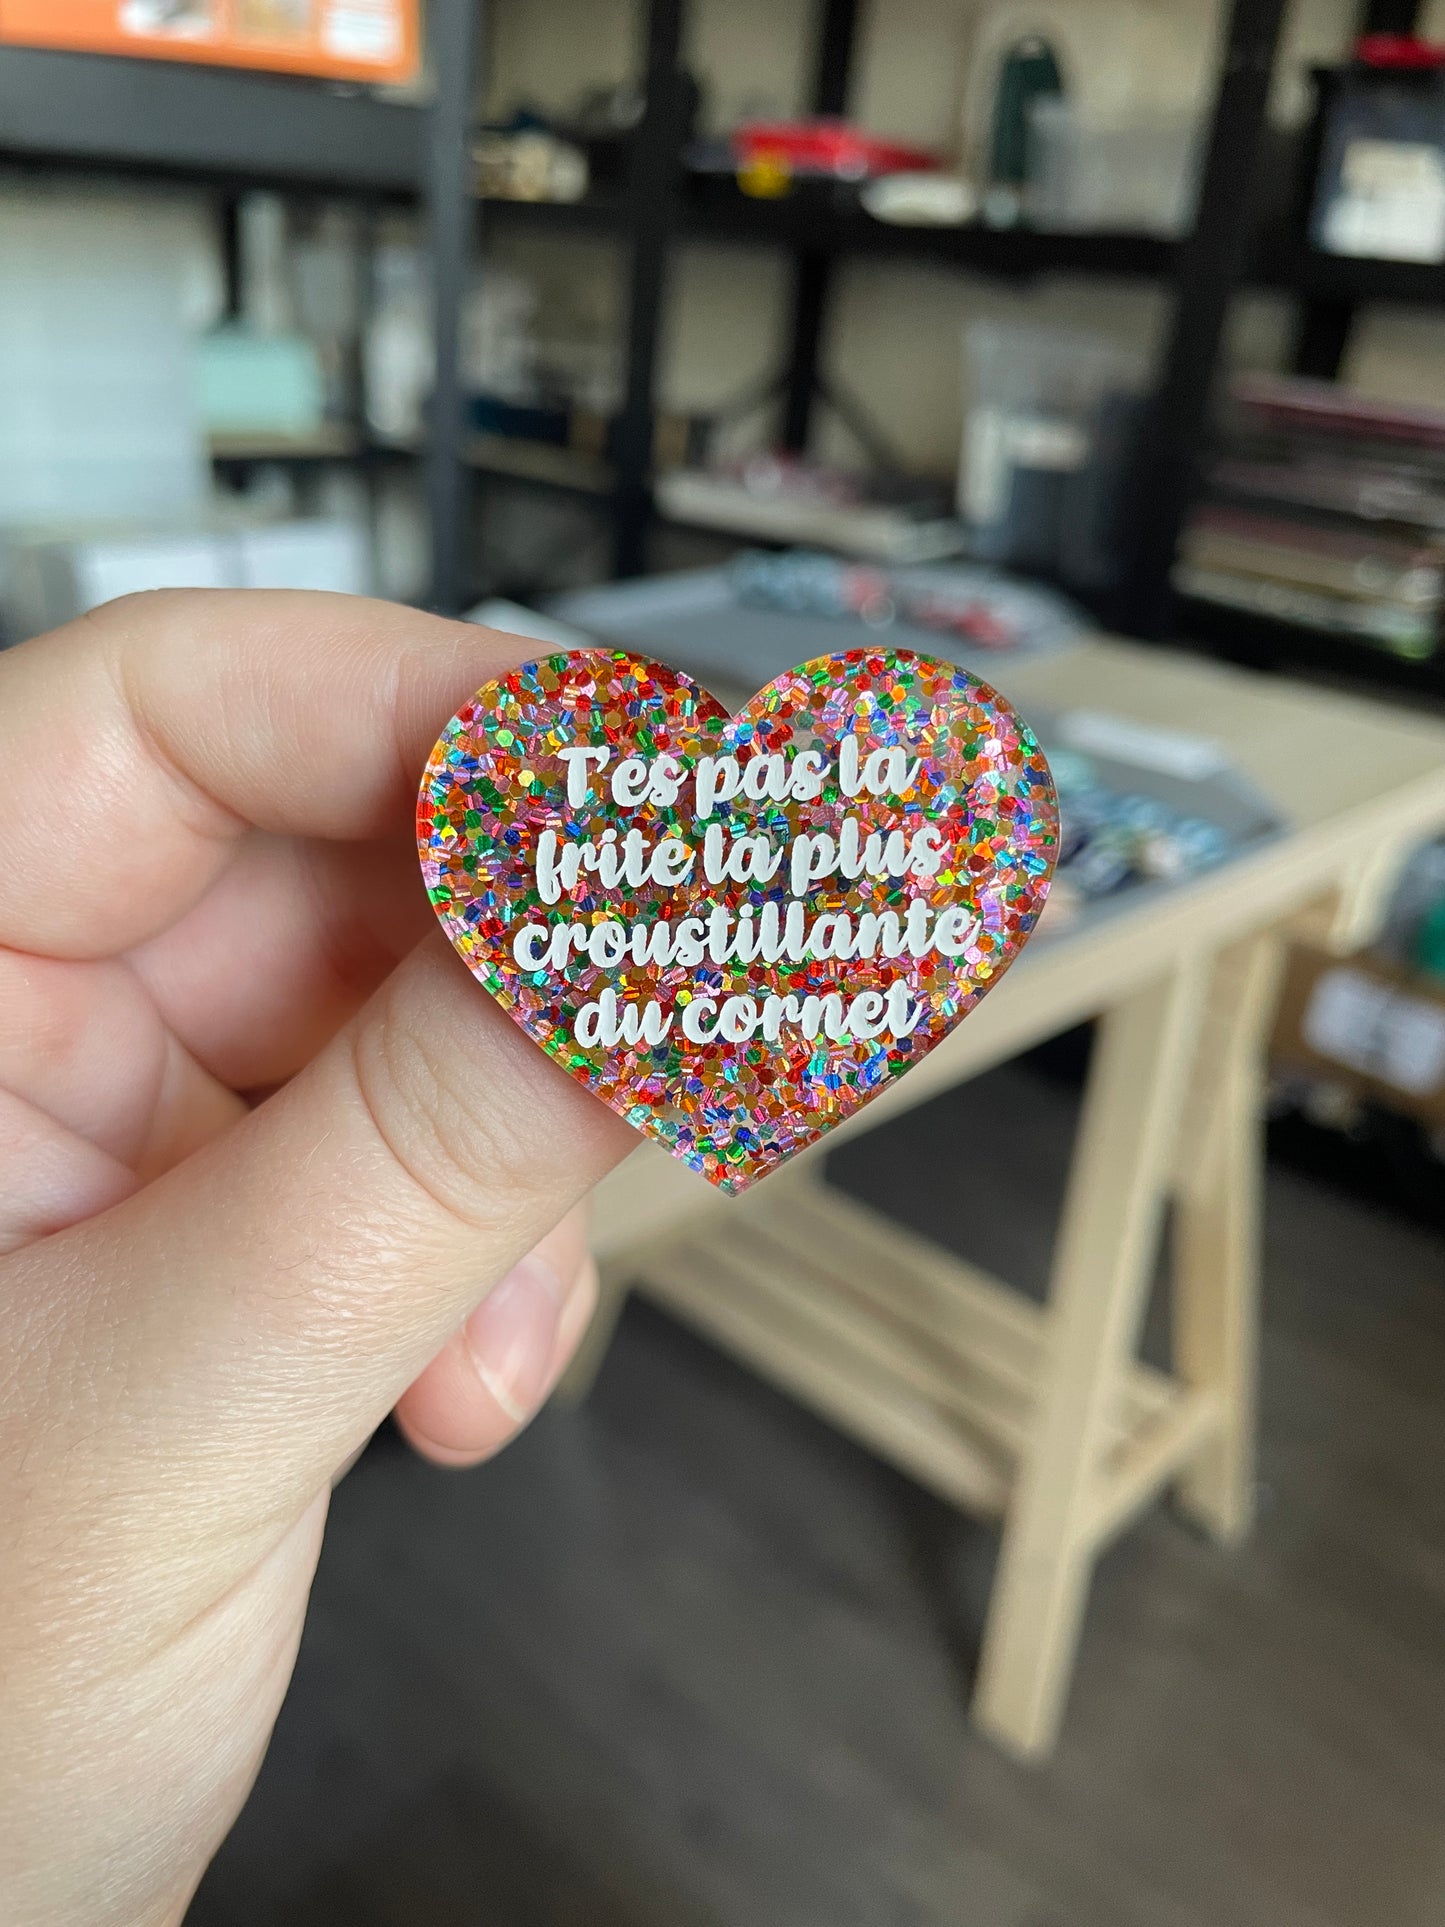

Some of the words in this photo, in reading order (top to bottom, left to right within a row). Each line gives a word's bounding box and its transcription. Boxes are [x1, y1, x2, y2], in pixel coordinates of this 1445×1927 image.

[557, 745, 688, 809] T'es
[695, 748, 832, 820] pas
[838, 733, 923, 797] la
[536, 826, 697, 905] frite
[703, 823, 785, 885] la
[790, 816, 951, 898] plus
[513, 898, 984, 972] croustillante
[574, 987, 675, 1049] du
[681, 979, 923, 1045] cornet
